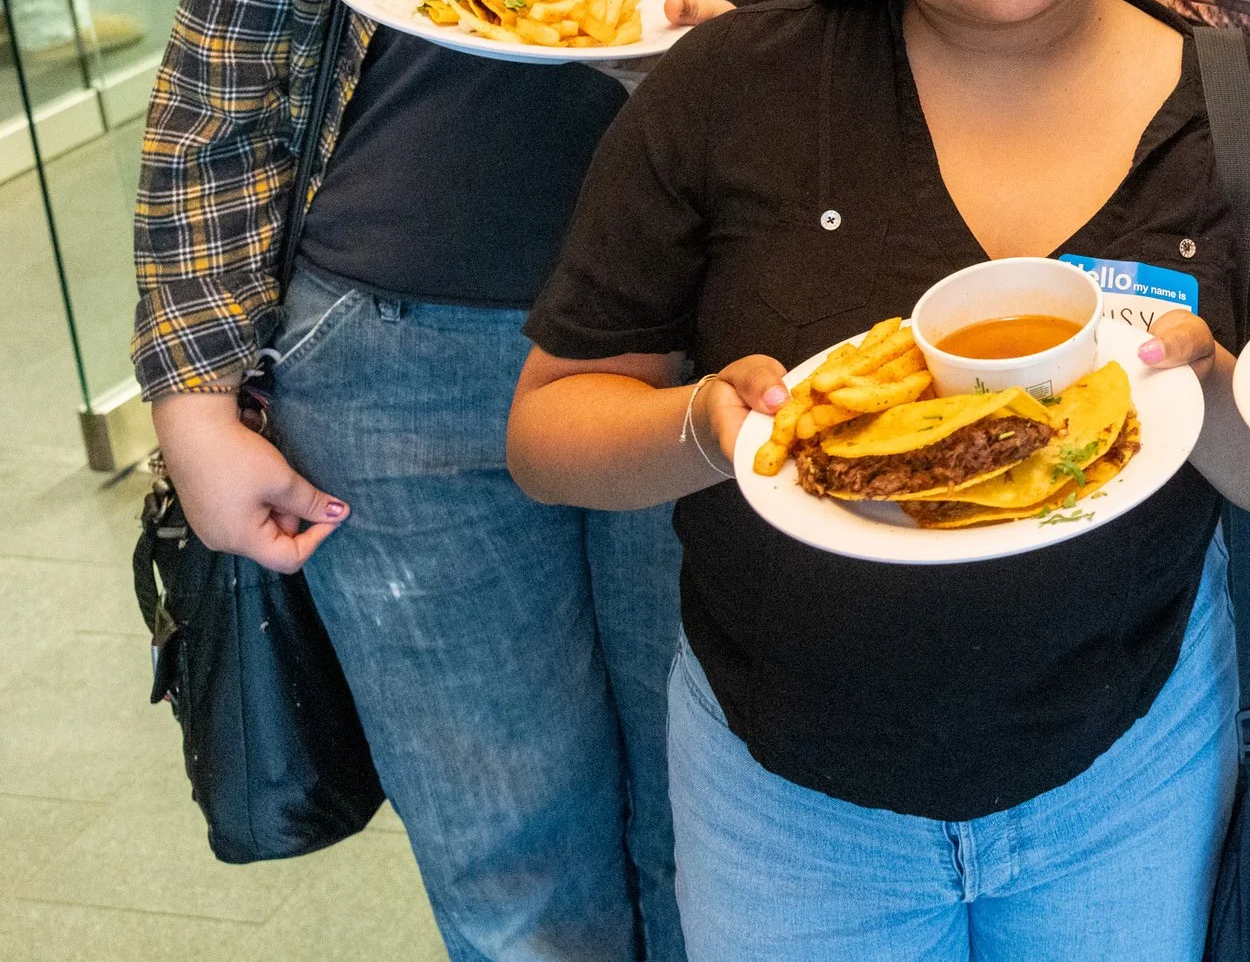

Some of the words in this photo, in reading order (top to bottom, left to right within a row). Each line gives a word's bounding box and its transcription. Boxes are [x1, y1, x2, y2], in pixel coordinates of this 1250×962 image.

[1067, 262, 1132, 290] ello
[1133, 283, 1148, 293] my
[1151, 286, 1176, 298] name
[1178, 291, 1186, 300] is
